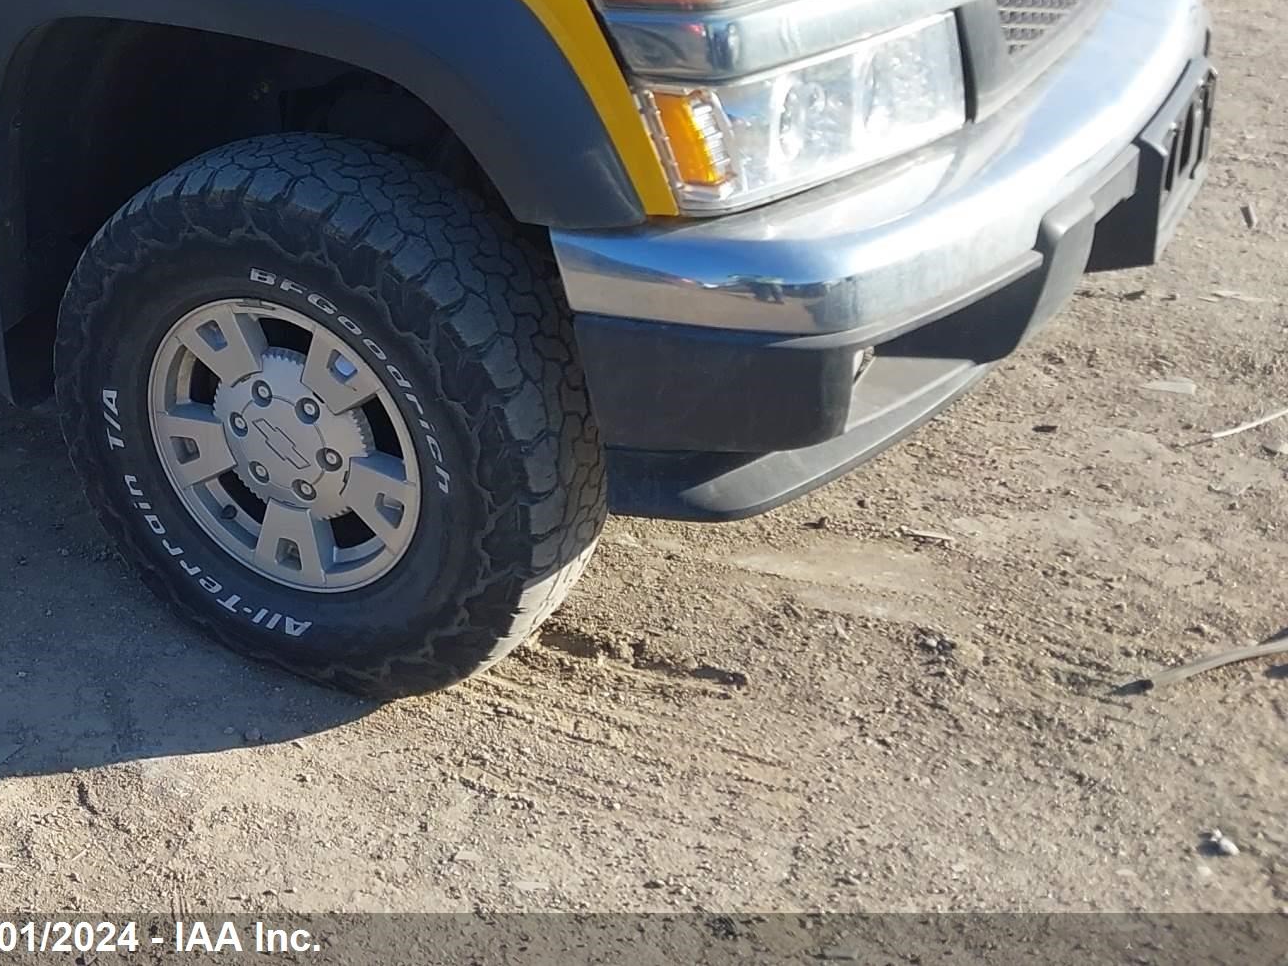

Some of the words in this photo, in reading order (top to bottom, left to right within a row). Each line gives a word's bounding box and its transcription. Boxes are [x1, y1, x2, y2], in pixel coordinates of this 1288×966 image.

[103, 389, 124, 450] T/A
[250, 267, 450, 494] BFGoodrich
[124, 475, 312, 636] All-Terrain
